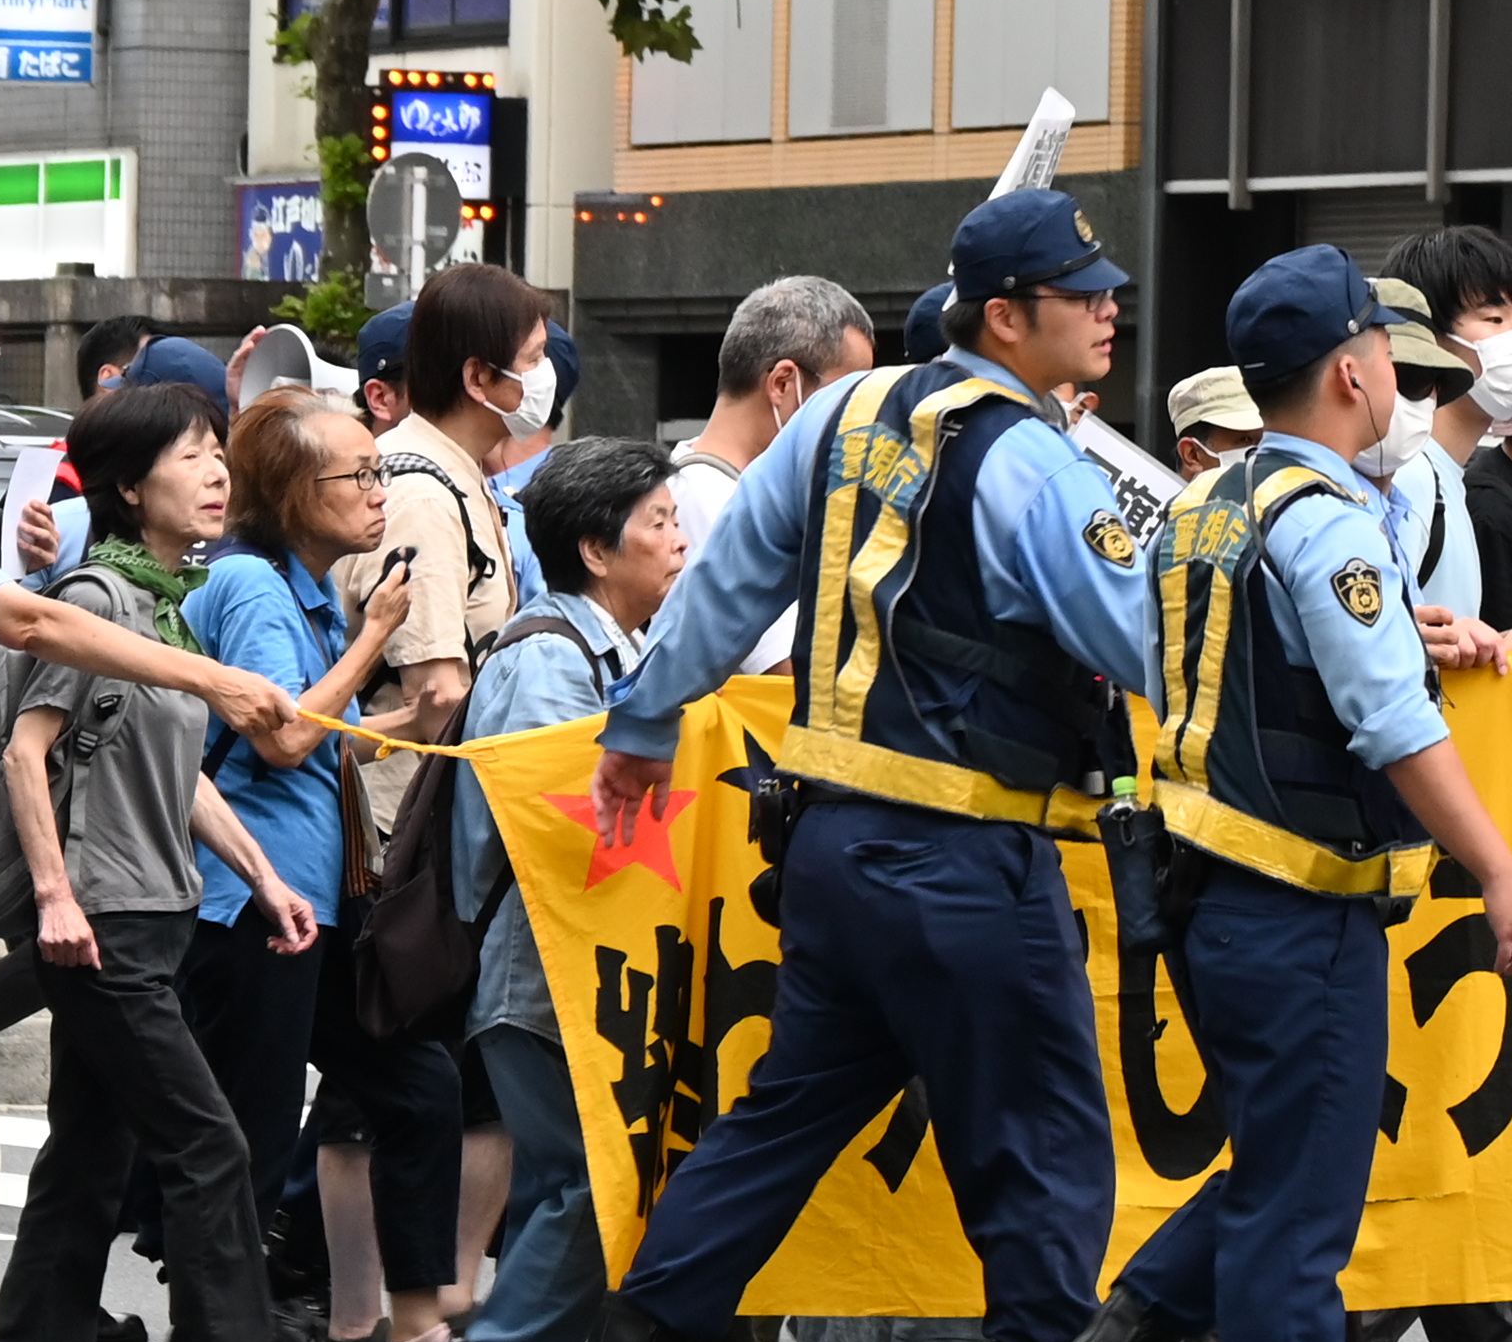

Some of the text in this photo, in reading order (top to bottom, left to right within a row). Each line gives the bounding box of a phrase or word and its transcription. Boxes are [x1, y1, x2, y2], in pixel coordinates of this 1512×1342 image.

[18, 49, 81, 78] たばこ
[841, 431, 921, 503] 警視庁
[1172, 508, 1247, 565] 警視庁
